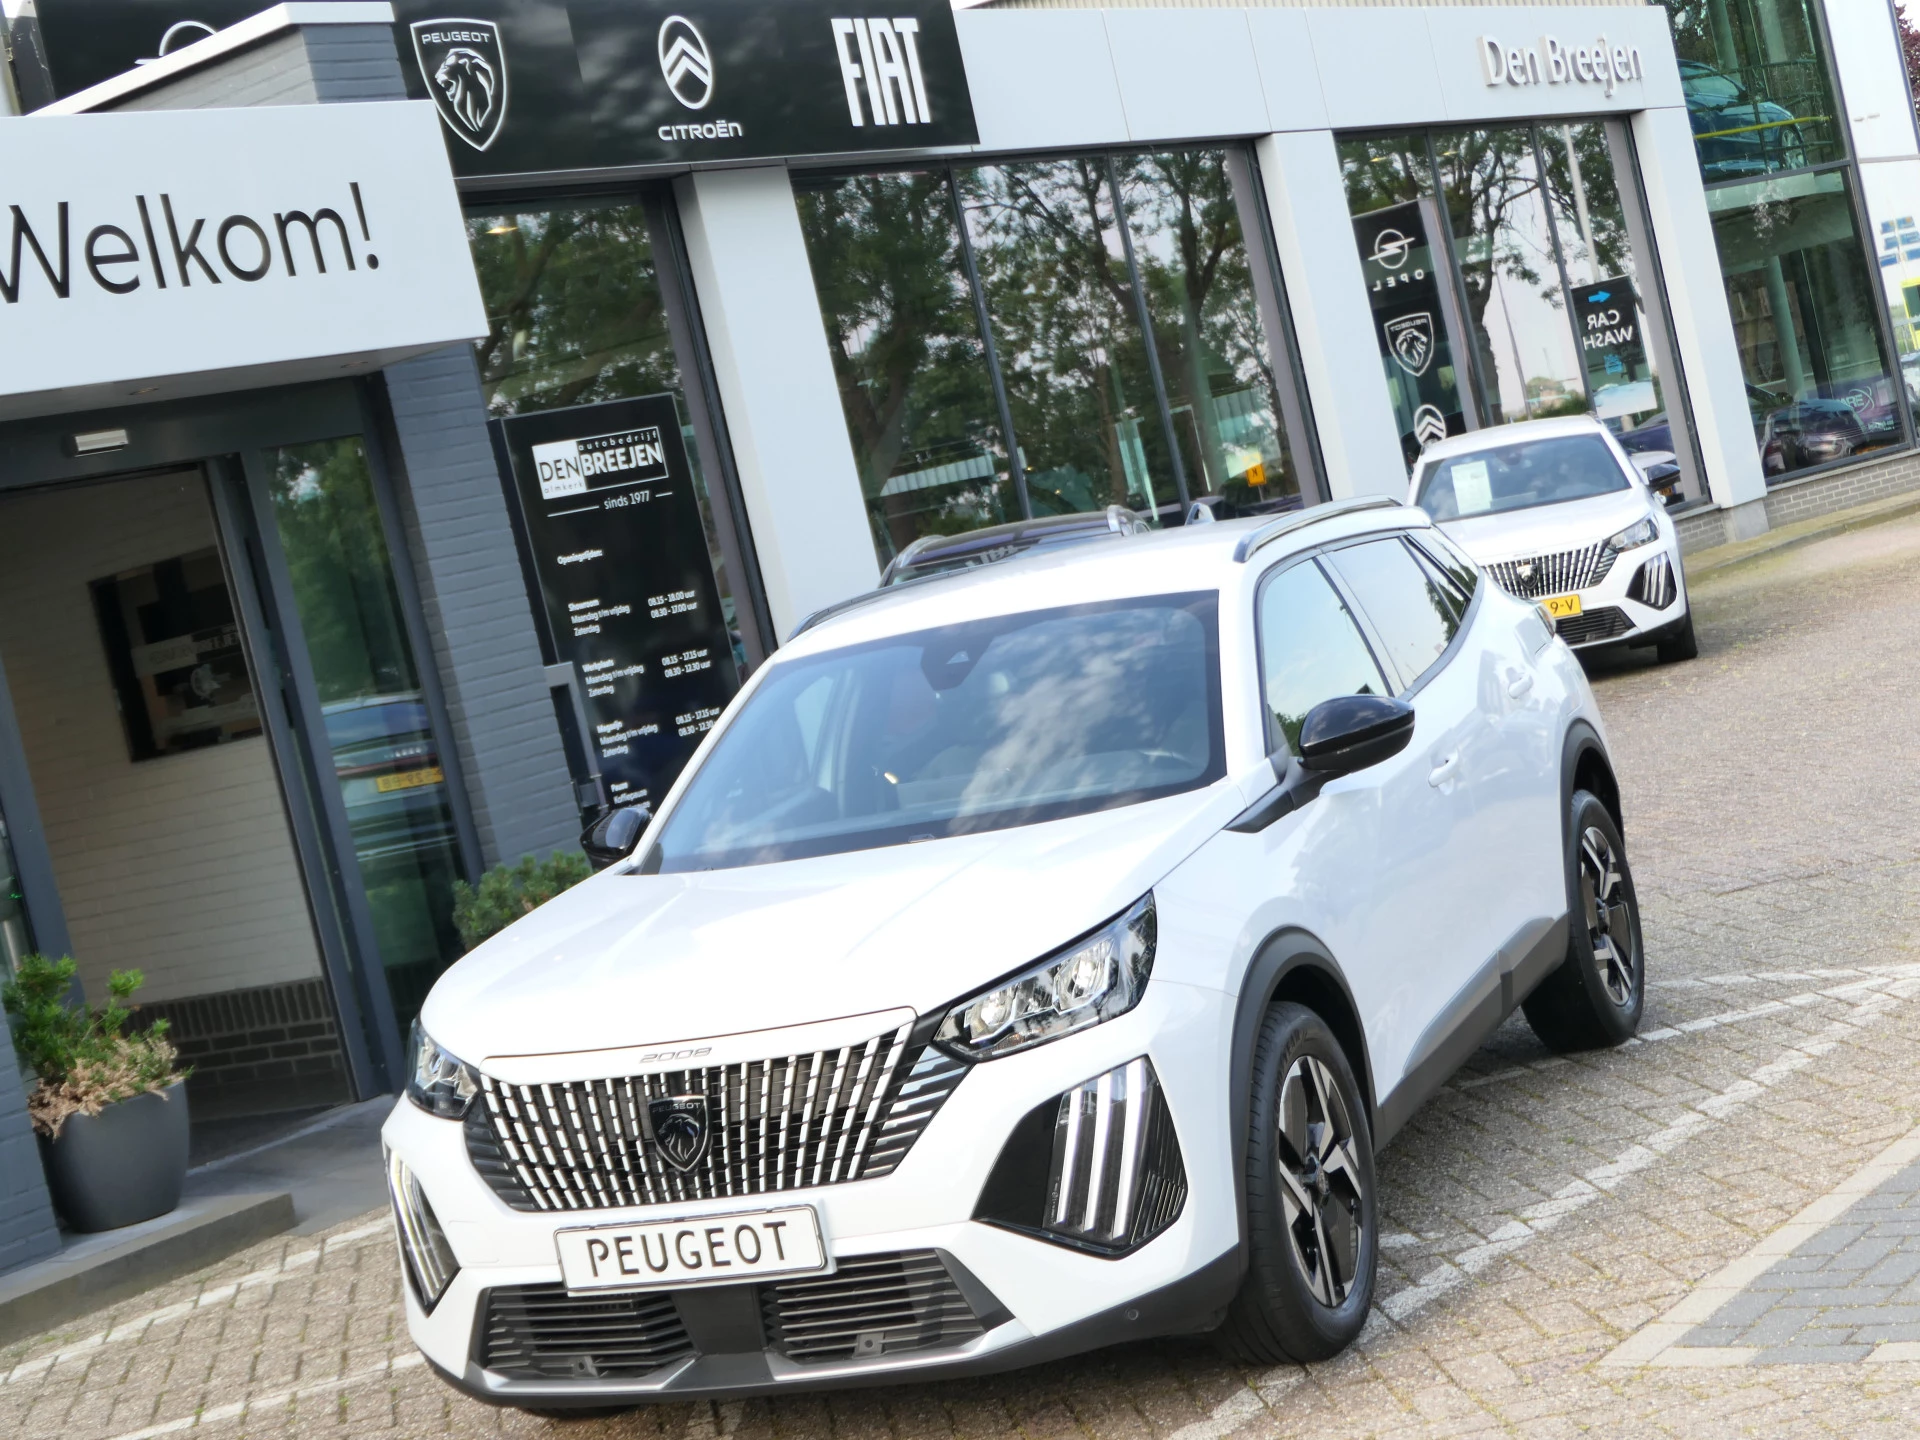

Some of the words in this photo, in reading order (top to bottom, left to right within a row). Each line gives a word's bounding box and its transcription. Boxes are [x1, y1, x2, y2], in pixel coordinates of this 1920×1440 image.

[421, 31, 490, 45] PEUGEOT
[831, 18, 931, 127] FIAT
[1478, 34, 1542, 86] Den
[1538, 32, 1645, 98] Breejen
[0, 182, 380, 304] Welkom!
[579, 430, 658, 451] autobedrijf
[604, 493, 628, 510] sinds
[629, 490, 650, 505] 1977
[639, 1047, 713, 1064] 2008
[652, 1102, 701, 1113] PEUGEOT
[586, 1220, 789, 1279] PEUGEOT
